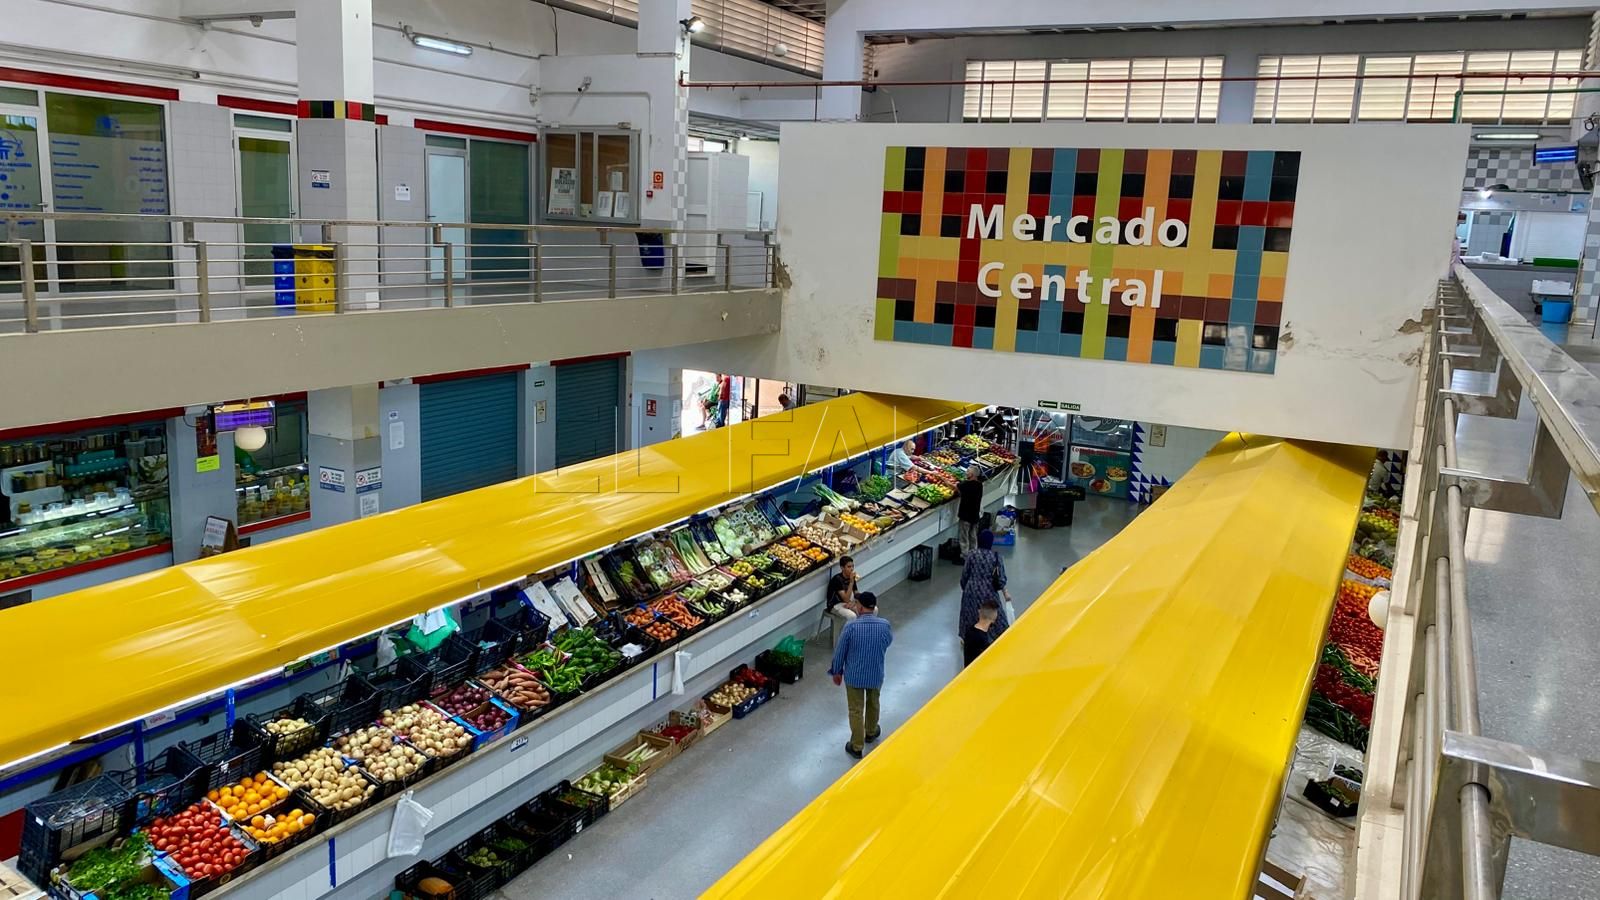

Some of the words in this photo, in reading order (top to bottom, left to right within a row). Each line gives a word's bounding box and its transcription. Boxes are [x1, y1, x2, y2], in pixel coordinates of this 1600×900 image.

[966, 204, 1187, 248] Mercado
[977, 262, 1164, 309] Central
[1060, 403, 1080, 411] SALIDA
